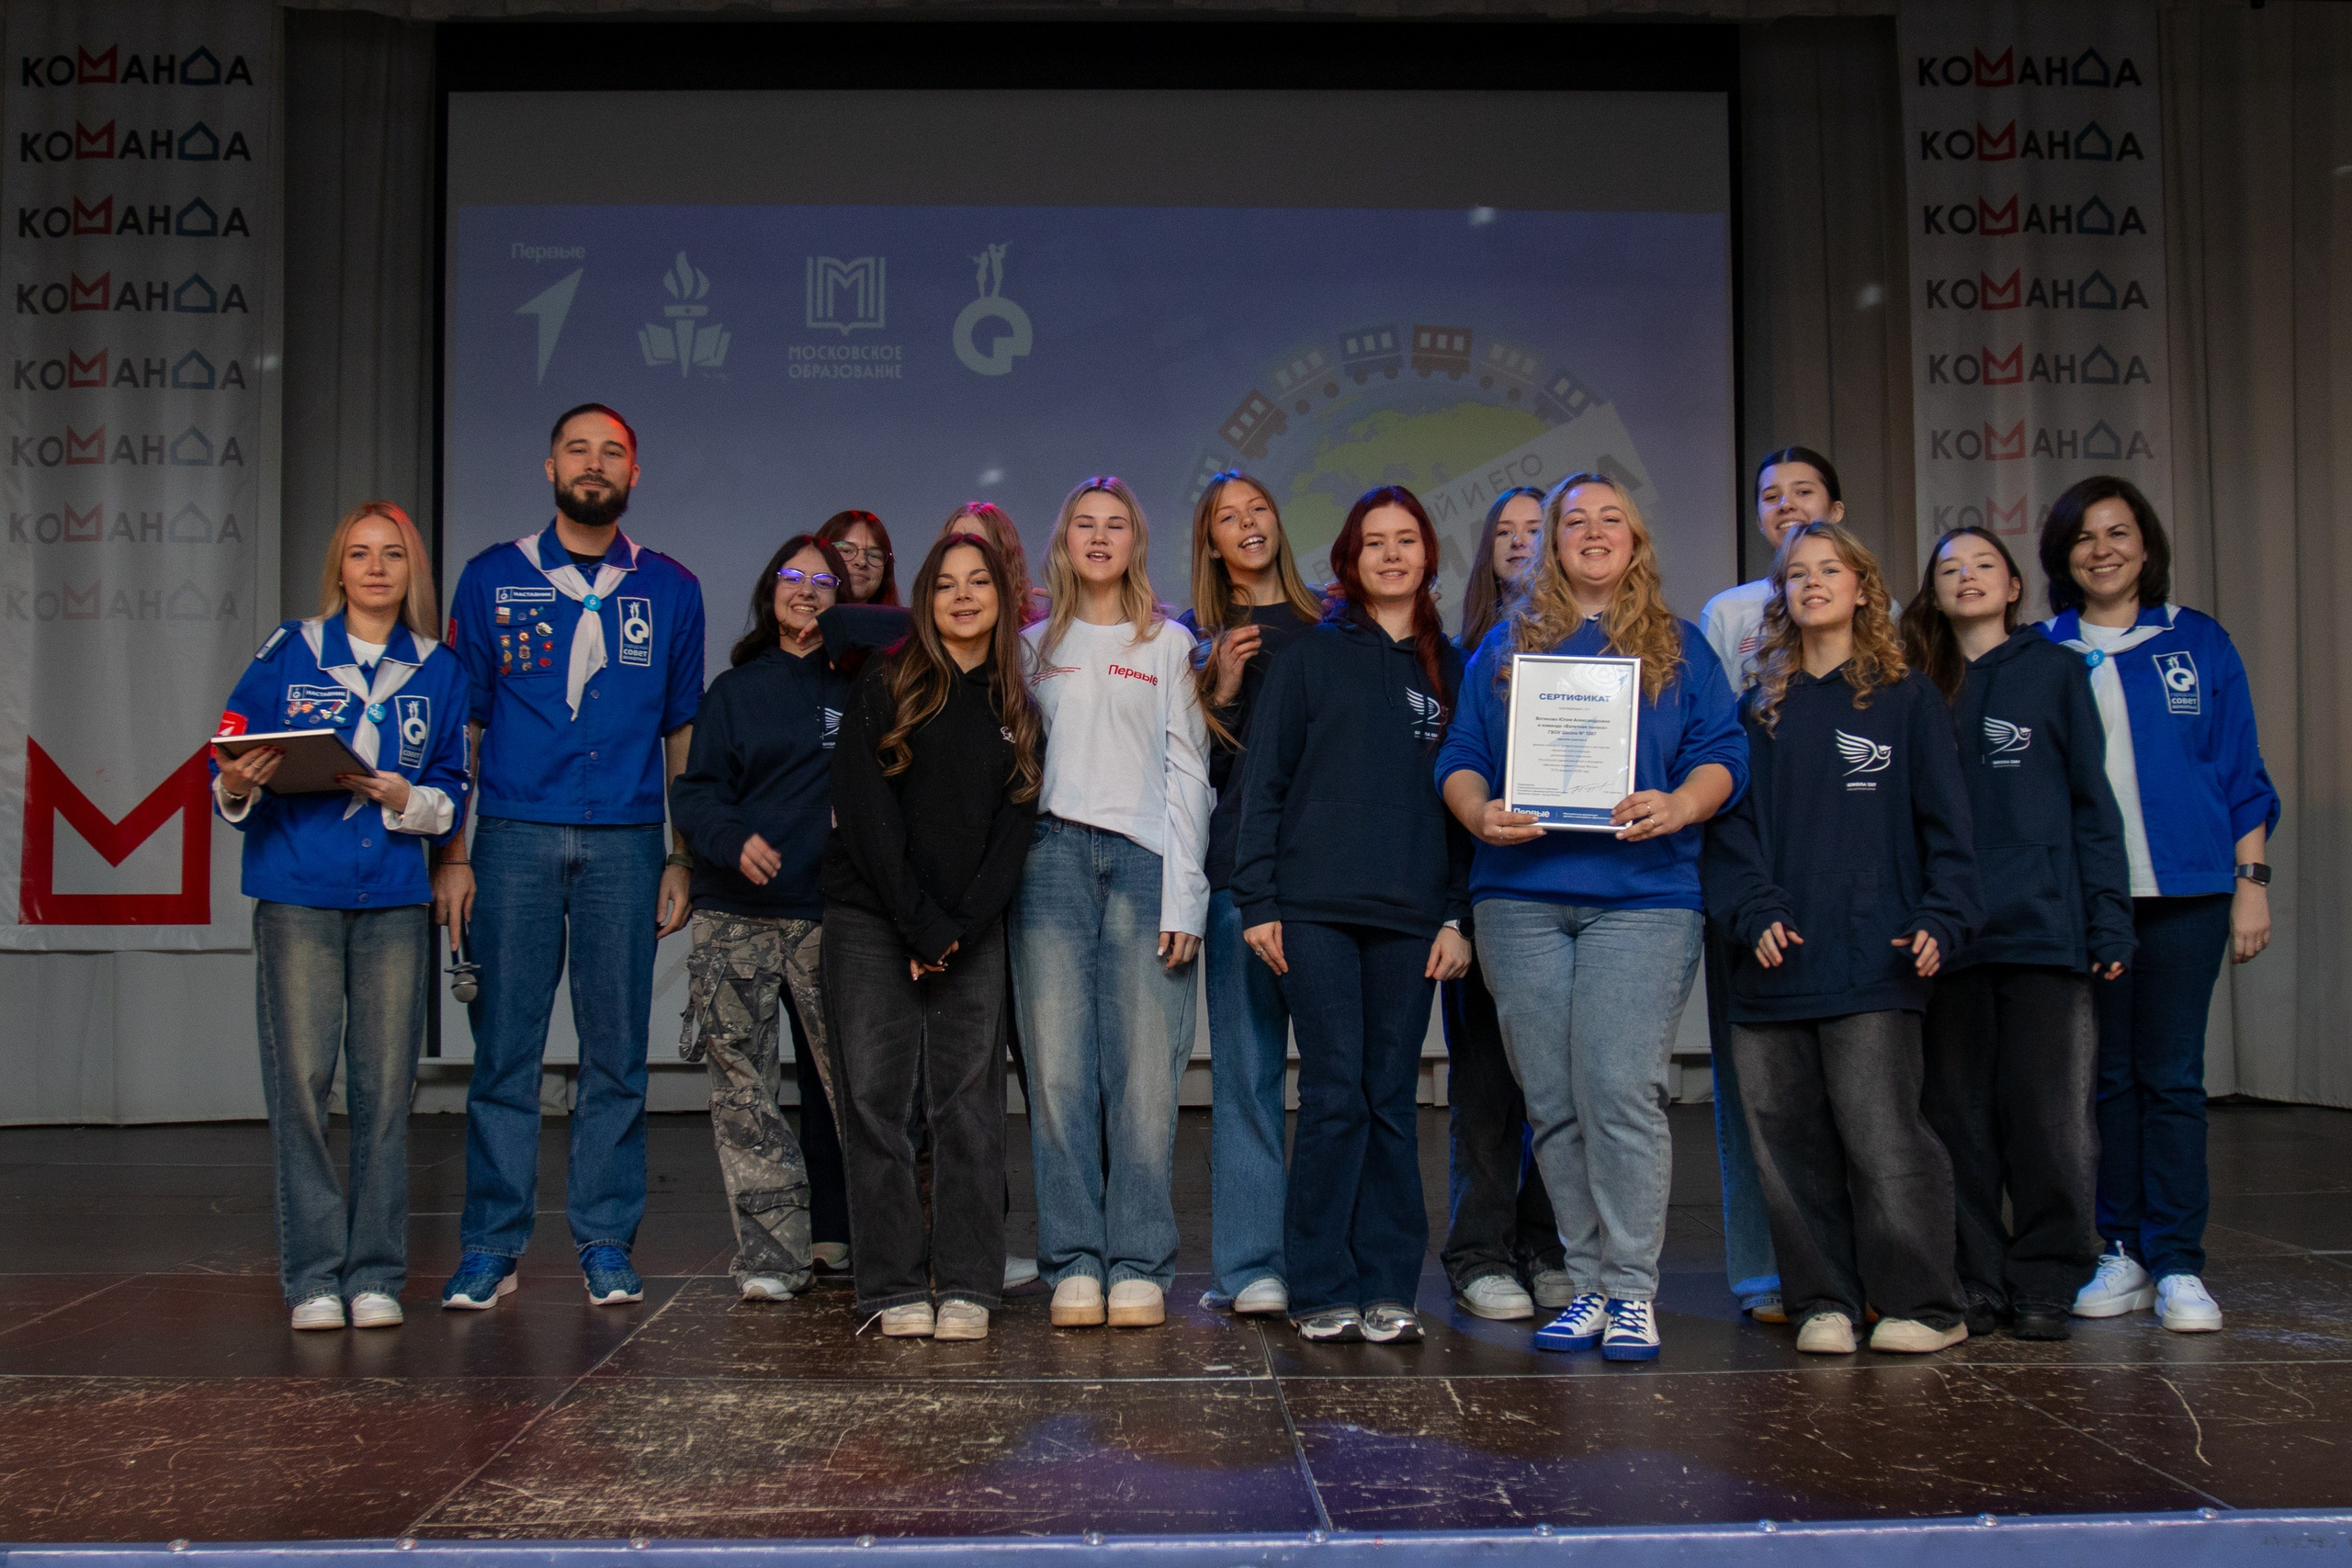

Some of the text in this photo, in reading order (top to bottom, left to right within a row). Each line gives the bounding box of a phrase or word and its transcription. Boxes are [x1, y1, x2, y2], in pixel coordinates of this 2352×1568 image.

[21, 44, 254, 87] КОМАНДА
[1918, 45, 2142, 87] КОМАНДА
[19, 118, 251, 163] КОМАНДА
[1921, 118, 2144, 162] КОМАНДА
[18, 195, 250, 238] КОМАНДА
[1924, 193, 2146, 236] КОМАНДА
[511, 243, 586, 263] Первые
[17, 271, 249, 314] КОМАНДА
[1928, 267, 2149, 310] КОМАНДА
[14, 347, 246, 390] КОМАНДА
[788, 344, 902, 362] МОСКОВСКОЕ
[788, 363, 903, 380] ОБРАЗОВАНИЕ
[1929, 343, 2151, 386] КОМАНДА
[11, 423, 243, 468] КОМАНДА
[1931, 418, 2154, 461] КОМАНДА
[9, 500, 242, 545] КОМАНДА
[305, 689, 346, 698] НАСТАВНИК
[1108, 664, 1159, 686] Первые
[1539, 693, 1611, 703] СЕРТИФИКАТ
